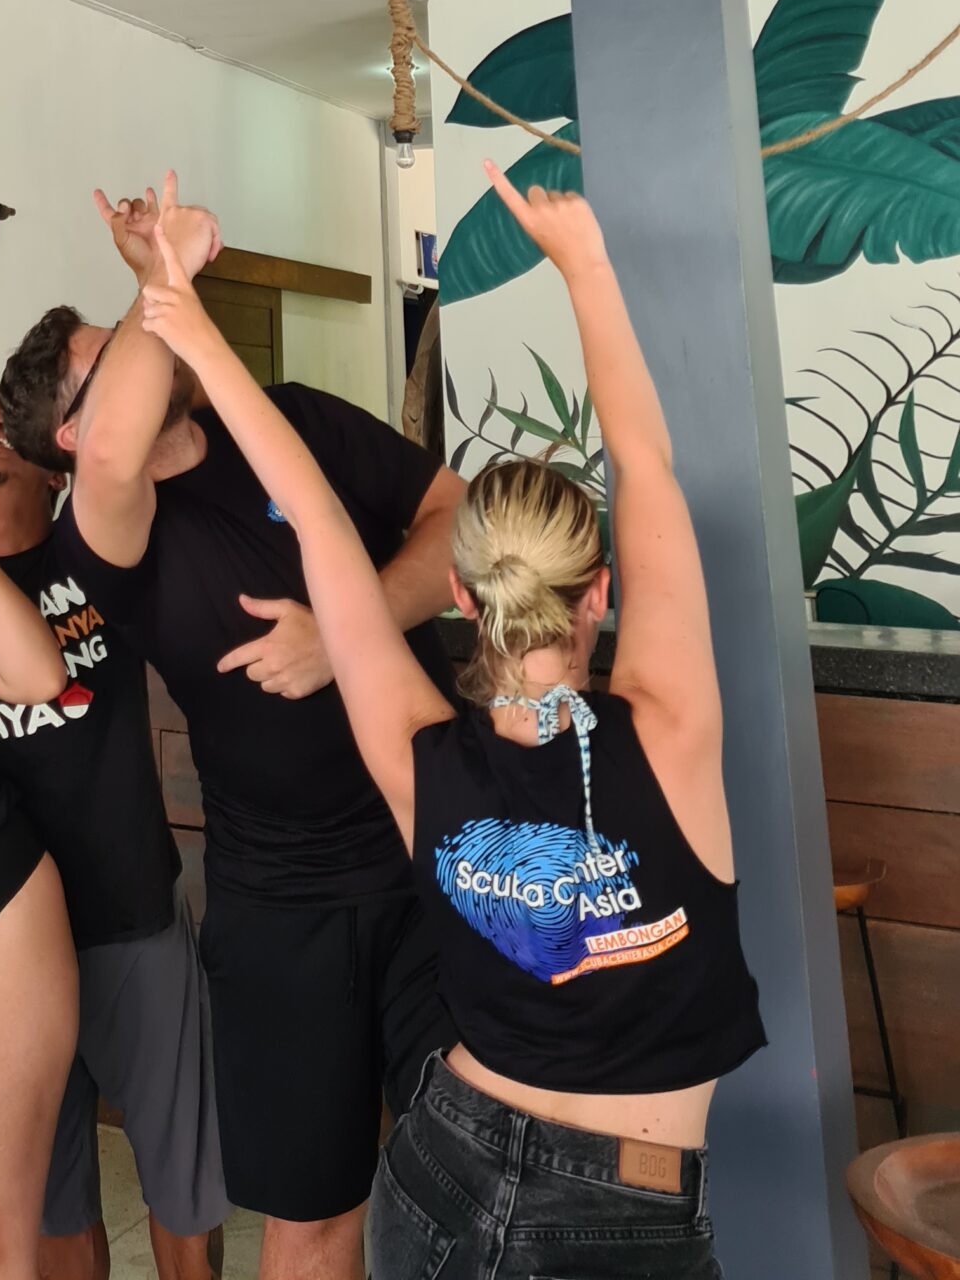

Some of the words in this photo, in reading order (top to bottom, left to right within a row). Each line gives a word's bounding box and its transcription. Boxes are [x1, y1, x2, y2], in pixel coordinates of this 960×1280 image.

[54, 605, 105, 648] NYA
[63, 635, 108, 678] NG
[553, 850, 627, 905] Cnter
[579, 886, 642, 921] Asia
[587, 911, 684, 953] LEMBONGAN
